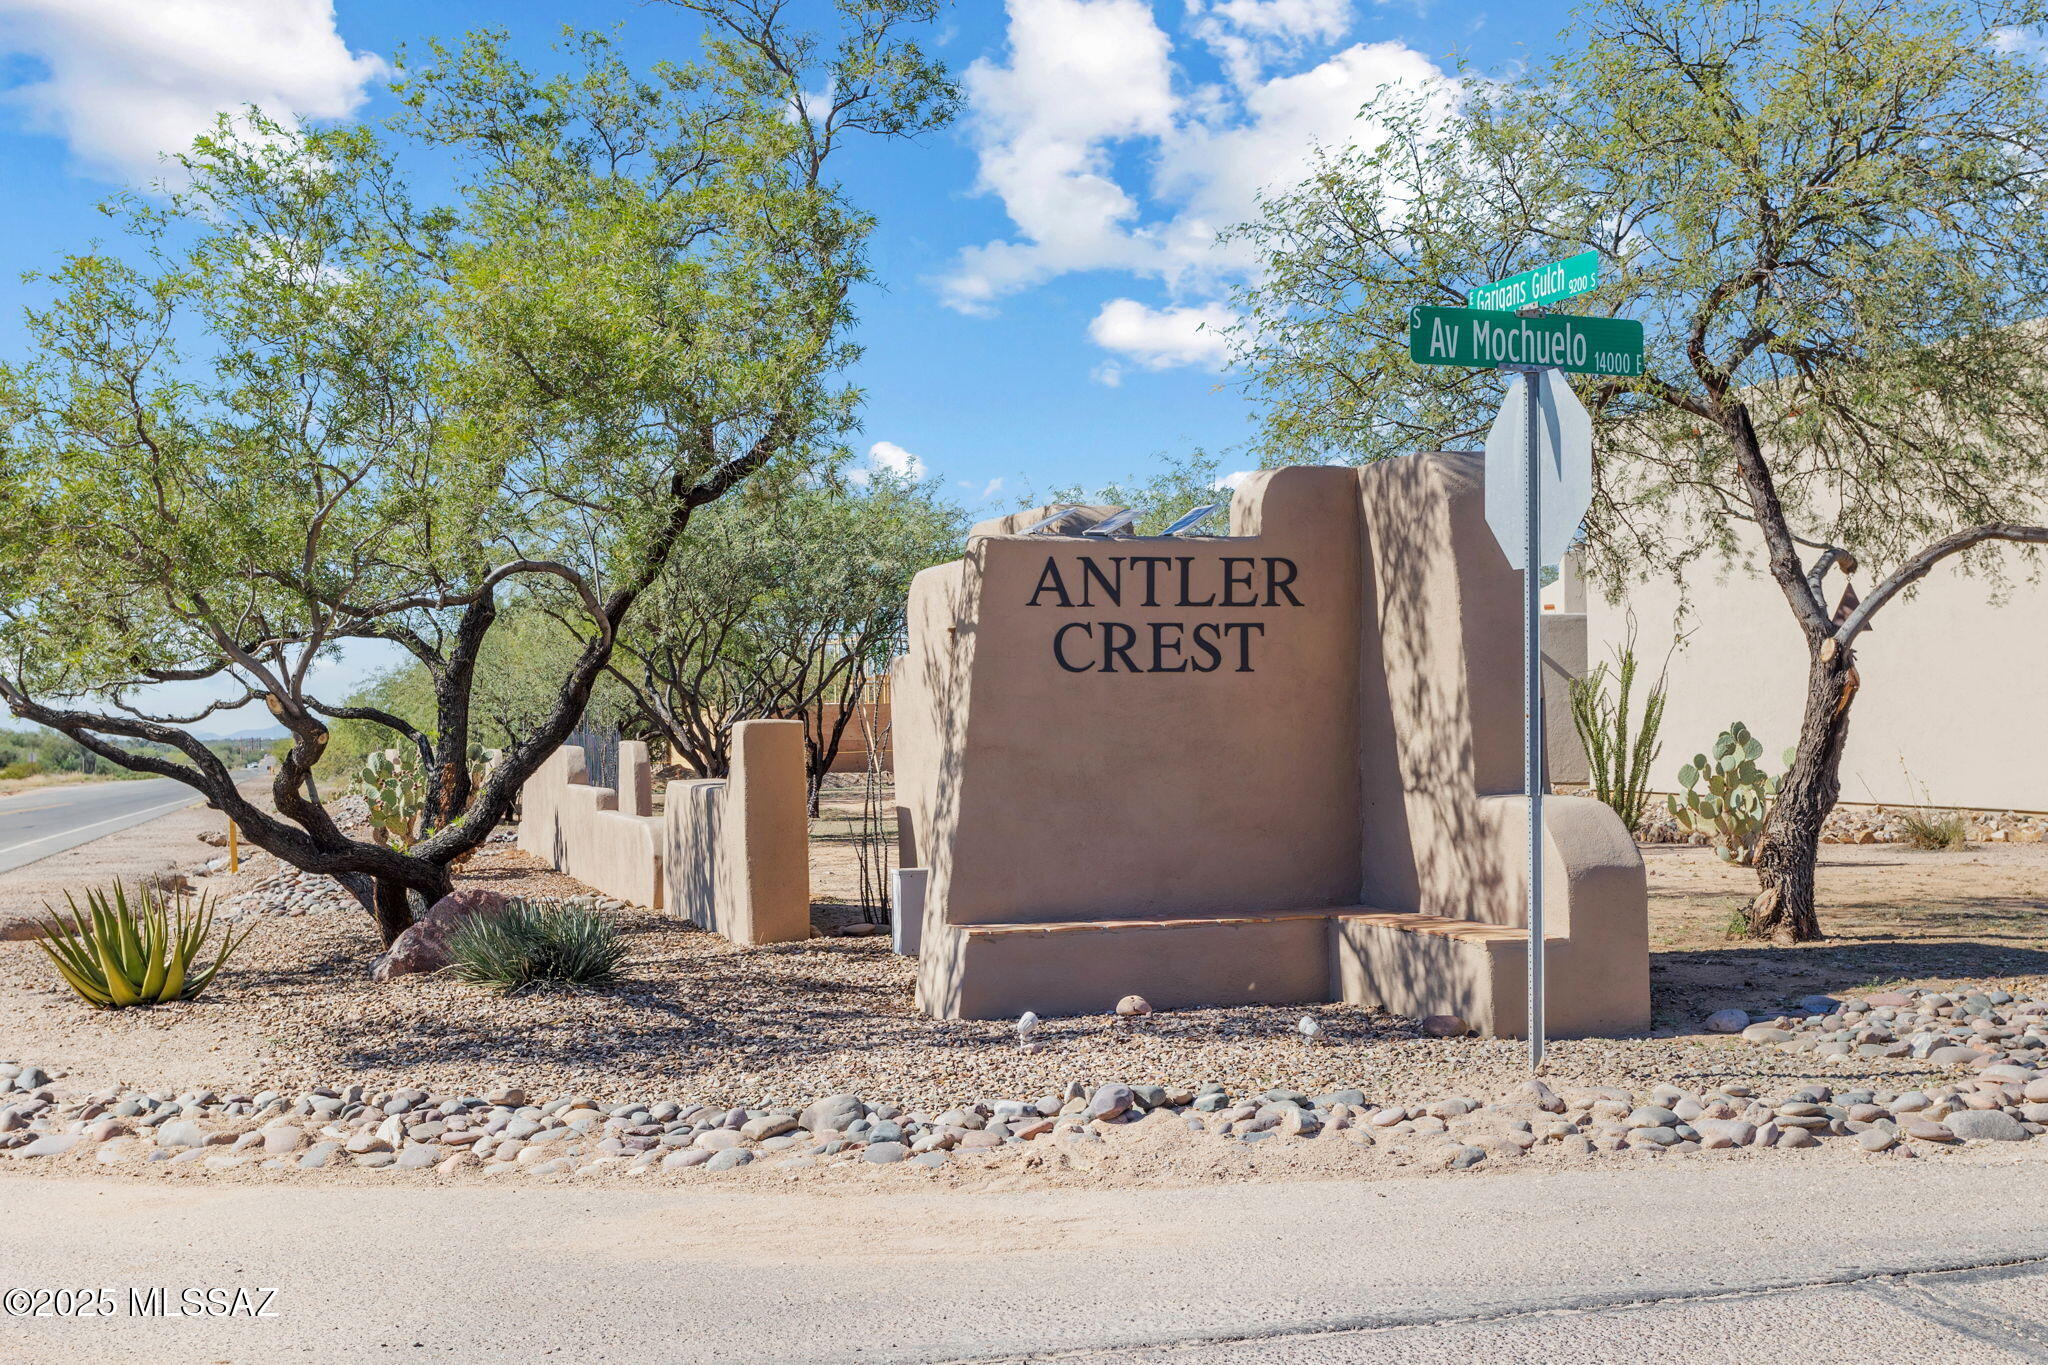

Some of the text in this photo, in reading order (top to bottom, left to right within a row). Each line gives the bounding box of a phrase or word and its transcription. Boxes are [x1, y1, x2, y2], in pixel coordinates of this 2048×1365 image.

[1469, 263, 1596, 311] E Garigans Gulch 9200 S
[1413, 307, 1642, 374] S Av Mochuelo 14000 E
[1025, 556, 1305, 608] ANTLER
[1053, 621, 1265, 673] CREST
